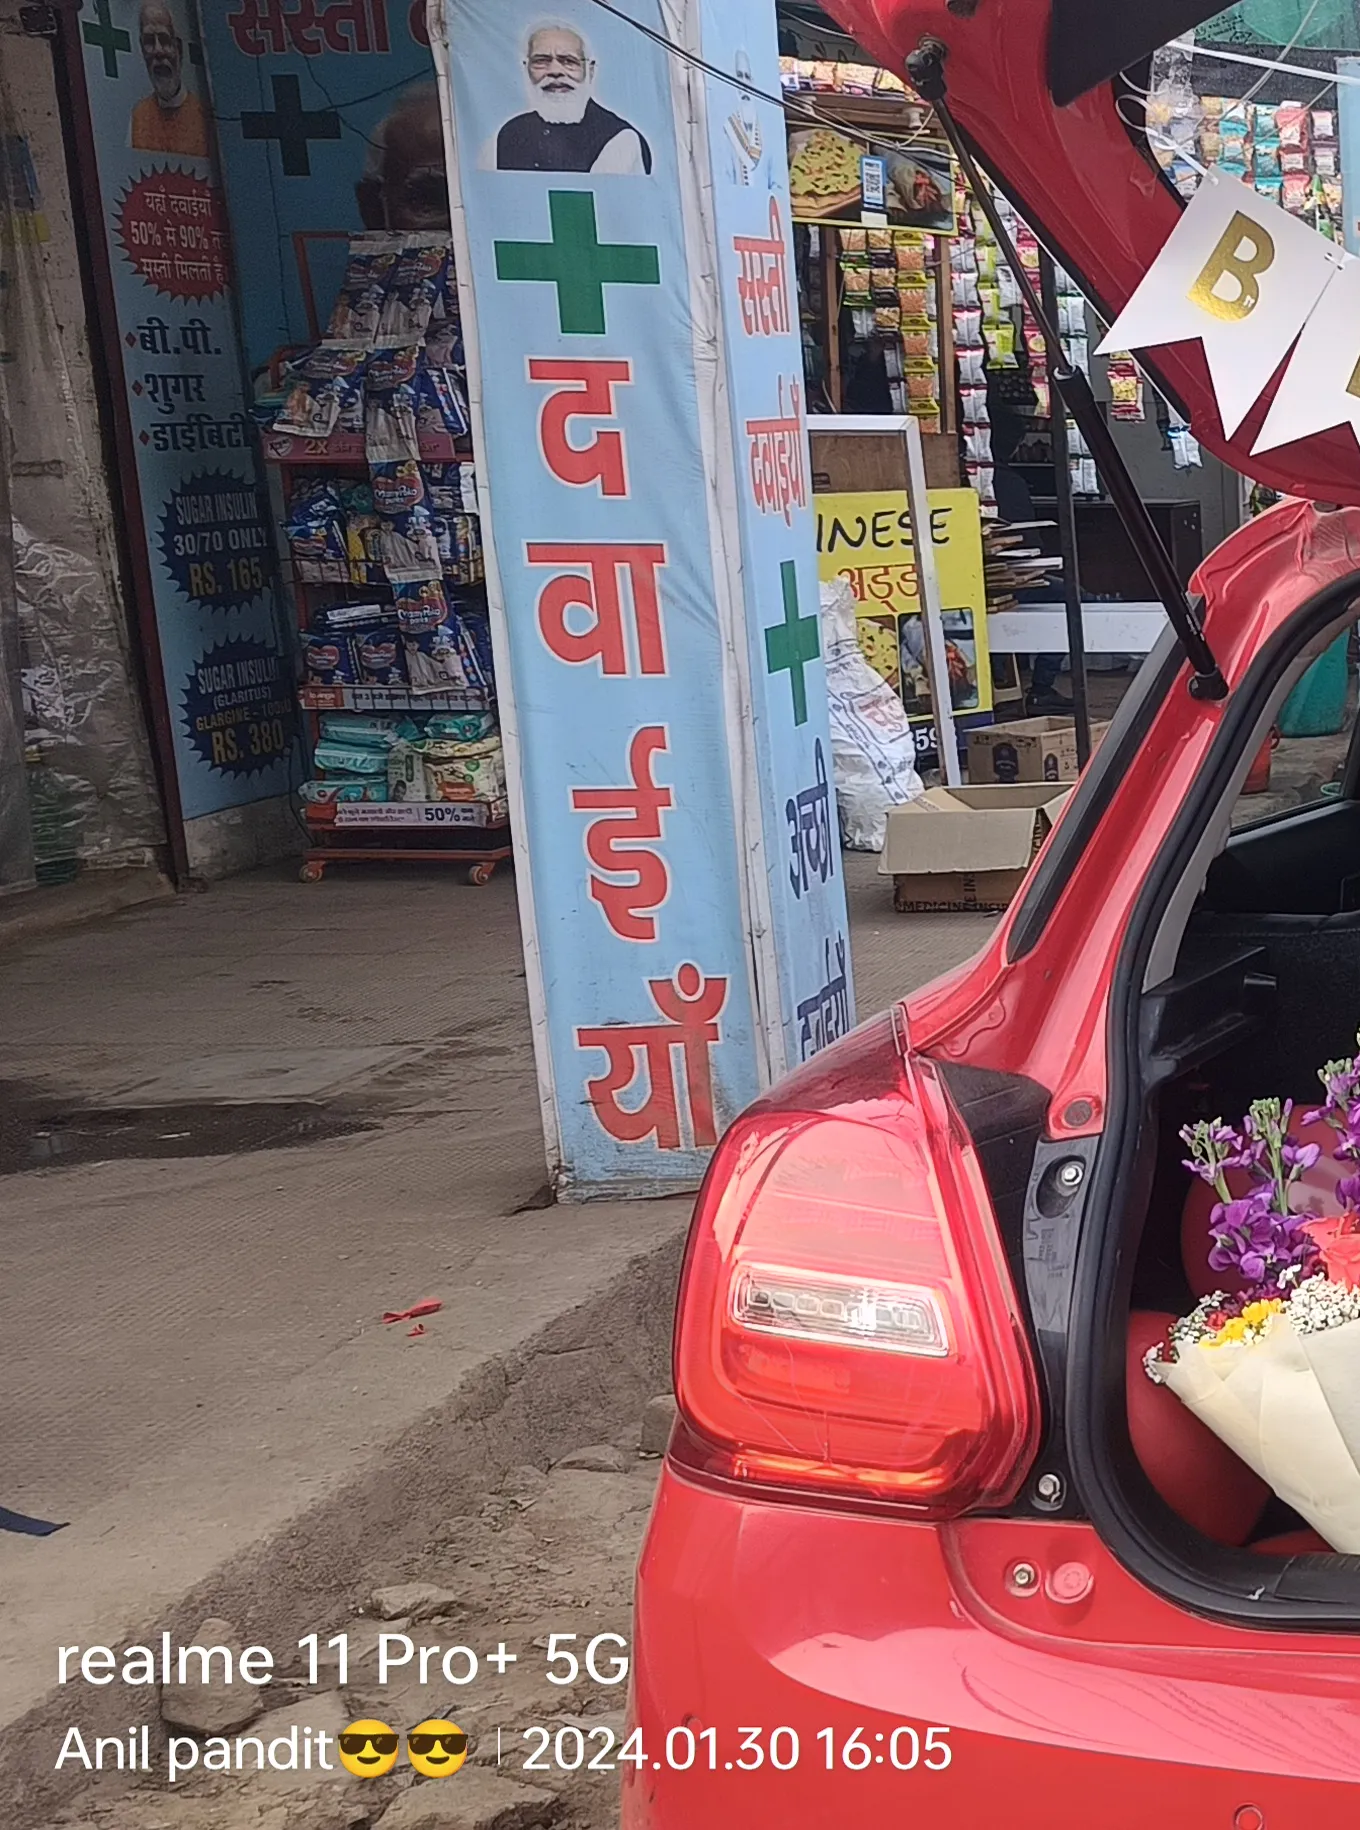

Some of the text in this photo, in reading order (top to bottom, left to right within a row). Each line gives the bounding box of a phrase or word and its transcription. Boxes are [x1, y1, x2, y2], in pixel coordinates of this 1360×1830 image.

[130, 221, 162, 247] 50%
[180, 225, 209, 250] 90%
[144, 373, 206, 414] शुगर
[150, 412, 252, 452] डाईबिटी
[175, 493, 258, 526] SUGAR INSULIN
[173, 527, 268, 557] 30/70 ONLY
[816, 508, 953, 554] INESE
[189, 556, 262, 598] RS. 165
[197, 663, 235, 695] SUGAR
[195, 706, 250, 732] GLARGINE
[211, 719, 284, 765] RS. 380
[424, 807, 461, 822] 50%
